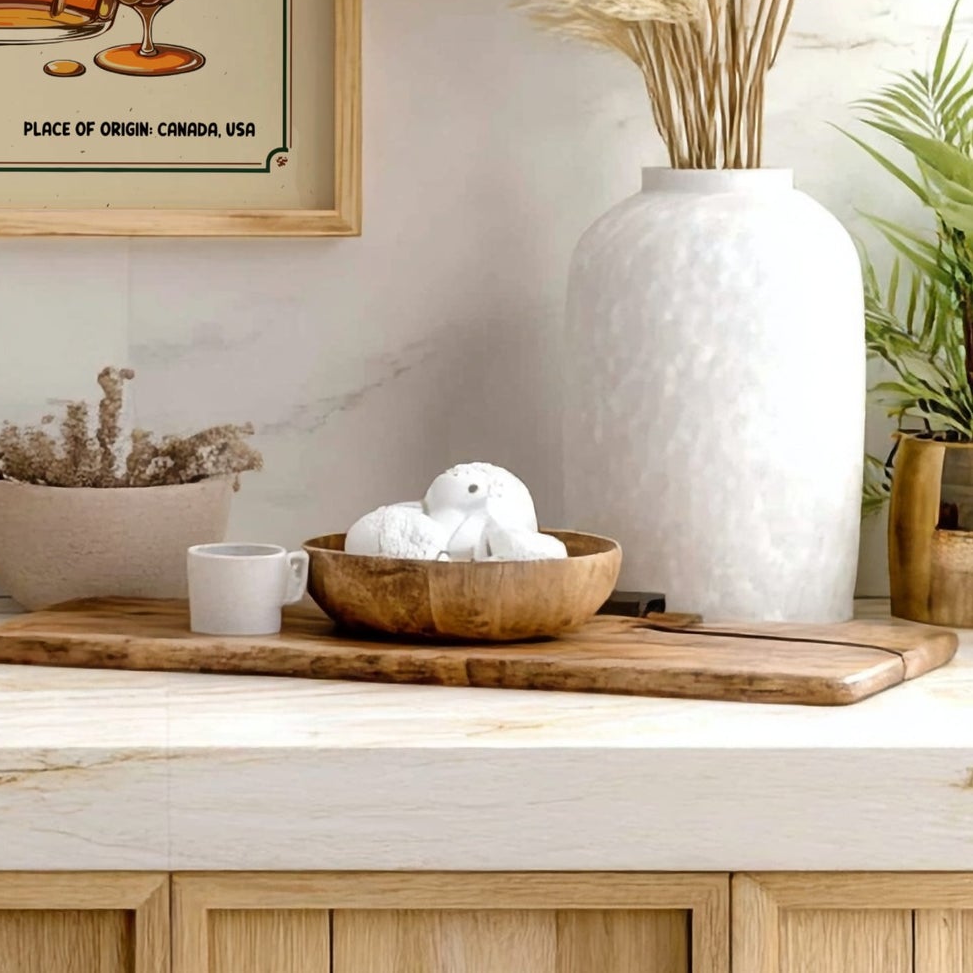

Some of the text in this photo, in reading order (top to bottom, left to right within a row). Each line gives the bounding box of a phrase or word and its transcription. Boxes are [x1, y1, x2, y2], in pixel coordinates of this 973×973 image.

[23, 121, 256, 138] PLACE OF ORIGIN: CANADA, USA
